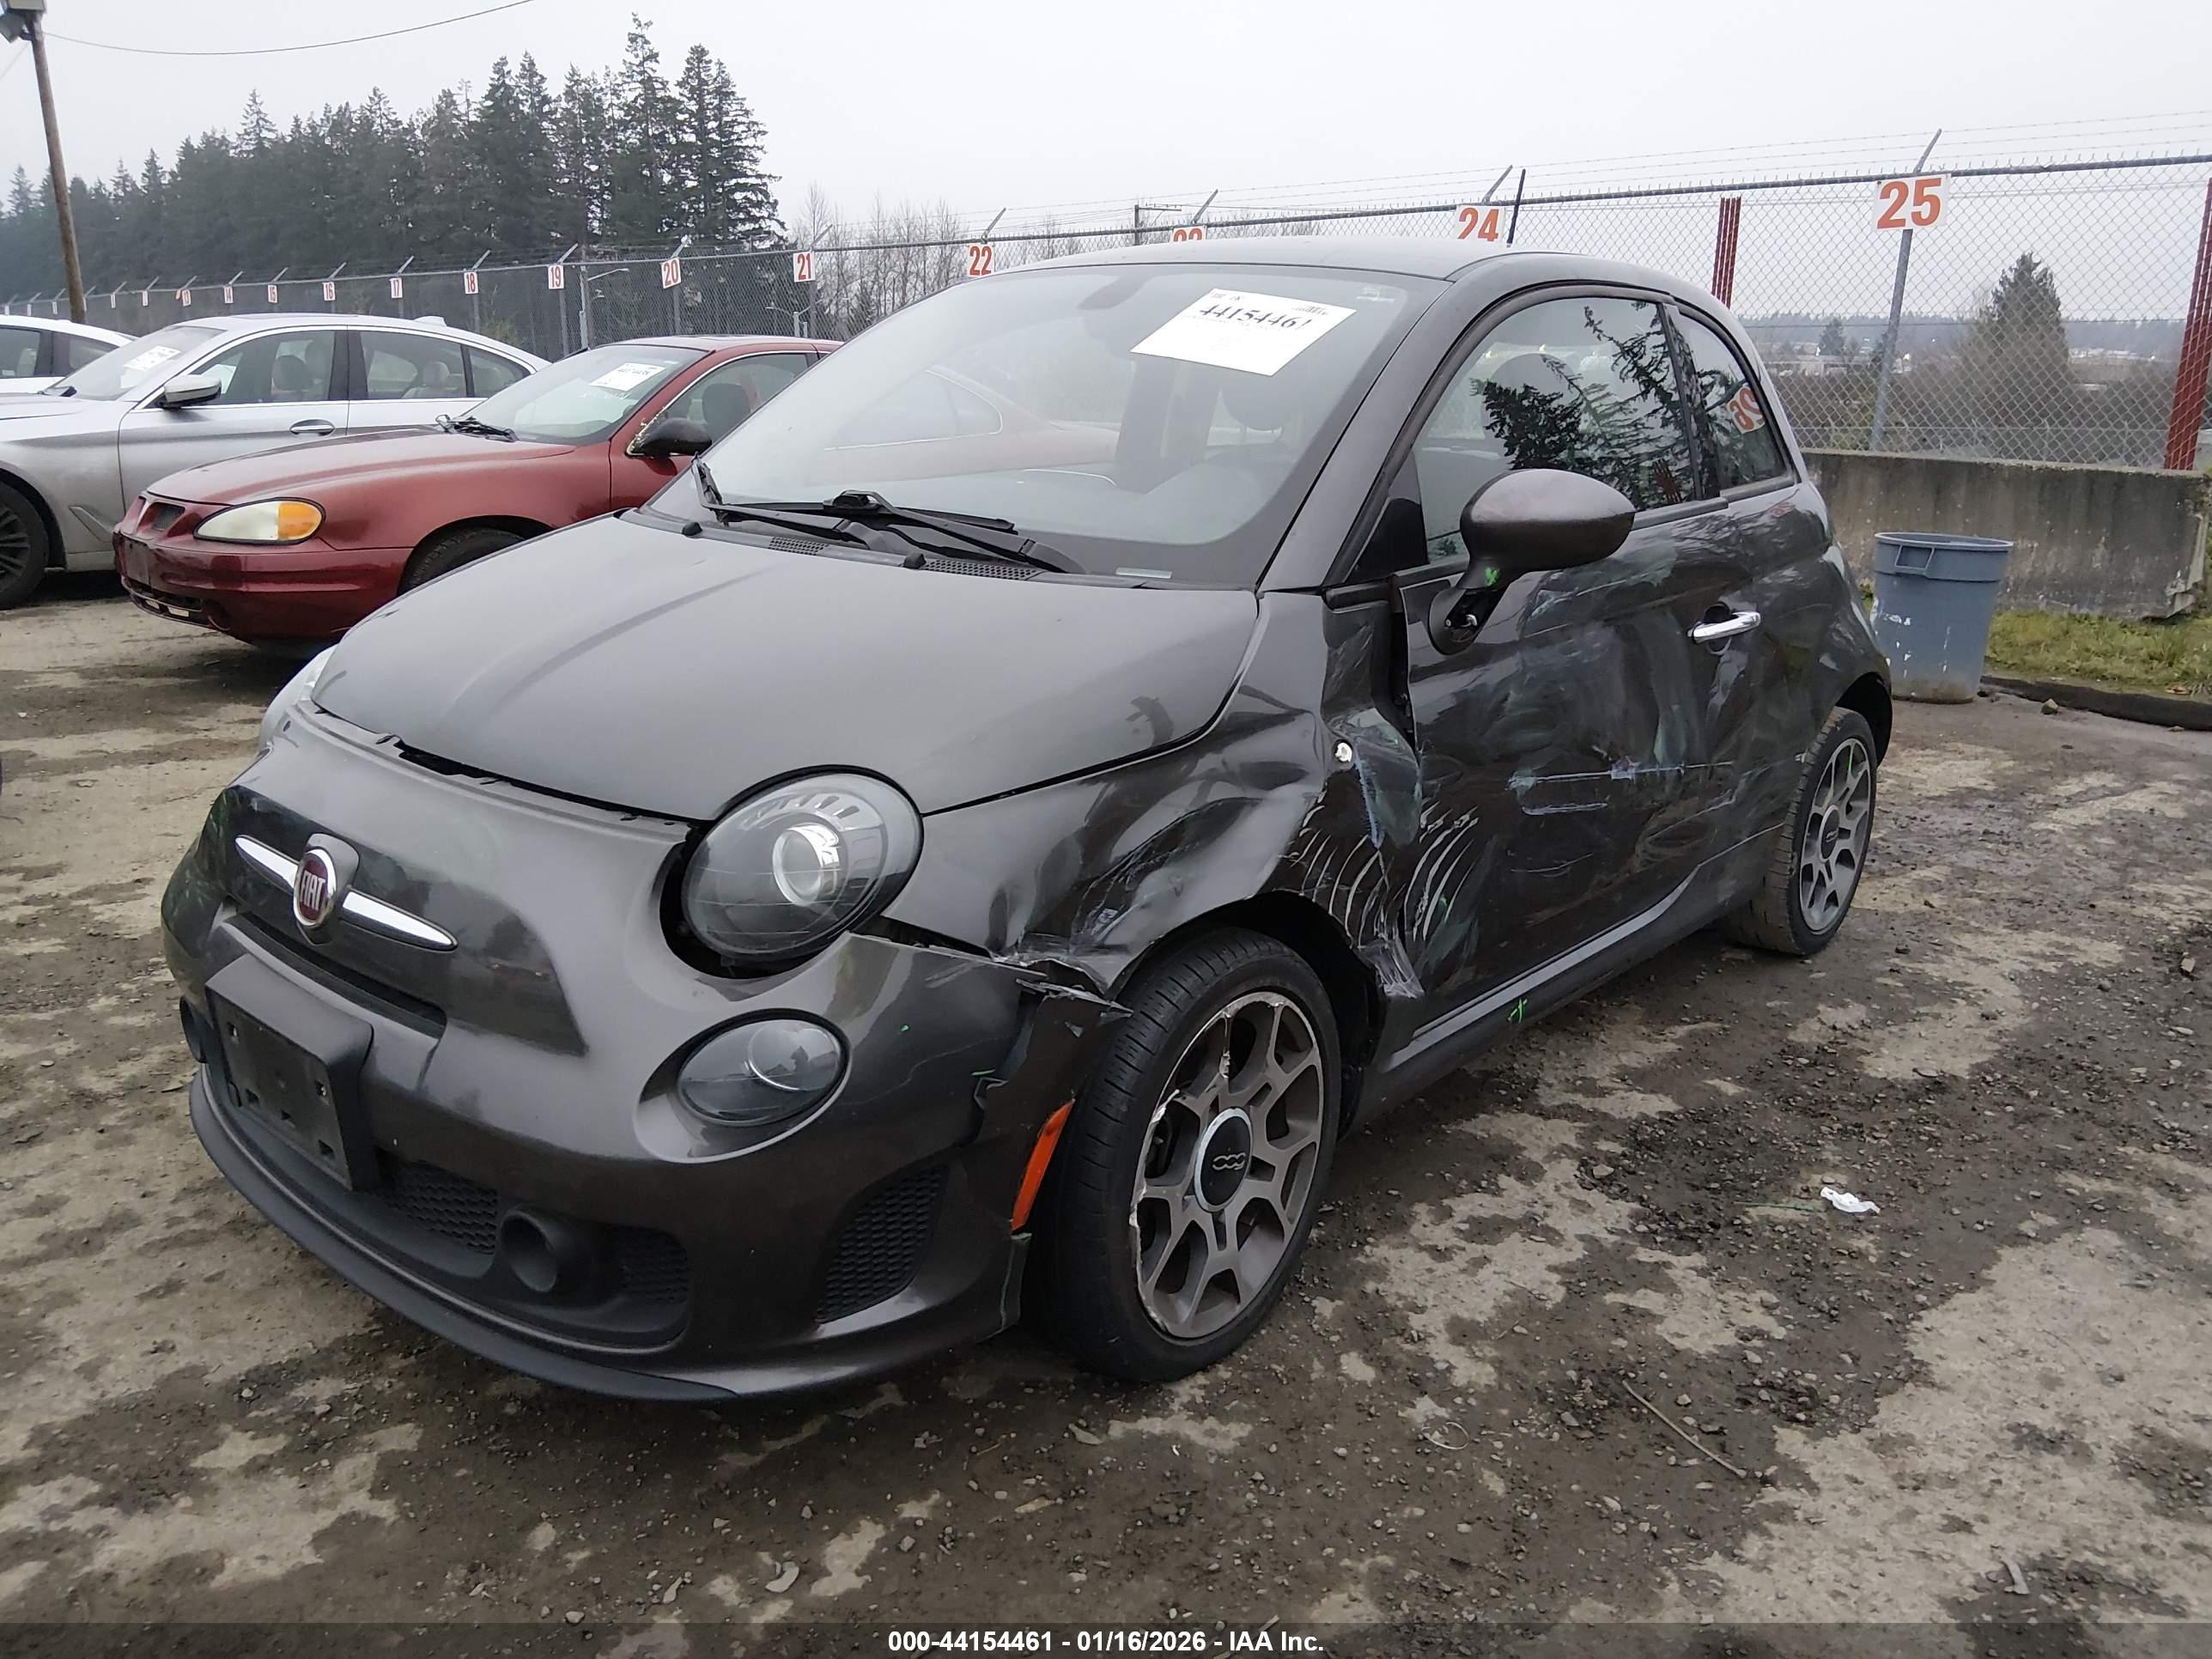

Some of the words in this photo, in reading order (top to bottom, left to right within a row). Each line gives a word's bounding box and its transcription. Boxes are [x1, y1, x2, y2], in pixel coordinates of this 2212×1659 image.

[1877, 178, 1942, 228] 25
[1457, 207, 1499, 241] 24
[664, 259, 678, 286] 20
[797, 253, 811, 280] 21
[969, 246, 992, 275] 22
[550, 265, 561, 288] 19
[300, 869, 326, 911] FIAT
